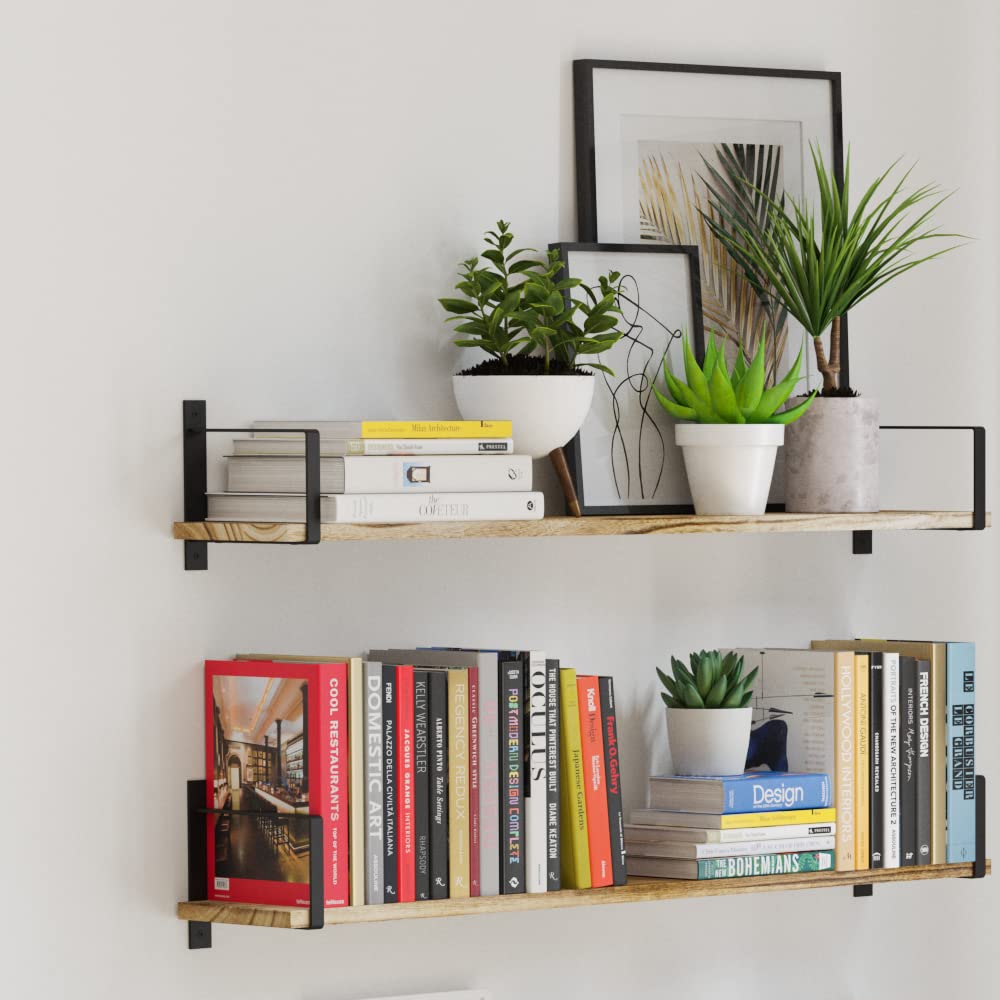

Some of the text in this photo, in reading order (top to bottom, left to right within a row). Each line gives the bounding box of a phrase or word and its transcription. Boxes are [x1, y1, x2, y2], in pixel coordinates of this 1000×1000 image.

[329, 677, 339, 716] COOL
[385, 682, 393, 704] FENDI
[586, 687, 597, 712] Knoll
[889, 659, 897, 704] PORTRAITS
[415, 681, 427, 774] KELLY WEARSTLER
[435, 717, 443, 748] ALBERTO
[454, 683, 466, 760] REGENCY
[508, 688, 519, 762] POSTMODERN
[531, 671, 546, 781] OCULUS
[606, 715, 617, 747] Frank
[890, 704, 897, 716] OF
[919, 671, 929, 758] FRENCH DESIGN
[367, 675, 383, 841] DOMESTIC ART
[385, 720, 393, 757] PALAZZO
[840, 665, 852, 843] HOLLYWOOD INTERIORS
[952, 704, 964, 790] LE GRAND
[963, 671, 975, 800] LE CORBUSIER
[329, 720, 339, 822] RESTAURANTS
[435, 749, 443, 772] PINTO
[548, 667, 558, 859] THE HOUSE THAT PINTEREST BUILT DIANE KEATON
[455, 765, 466, 820] REDUX
[508, 764, 520, 805] DESIGN
[572, 749, 585, 831] Japanese Gardens
[752, 783, 804, 807] Design
[386, 818, 394, 857] ITALIANA
[419, 835, 427, 875] RHAPSODY
[509, 807, 520, 865] COMPLETE
[714, 869, 727, 878] NEW
[727, 853, 800, 878] BOHEMIANS
[716, 859, 727, 869] THE
